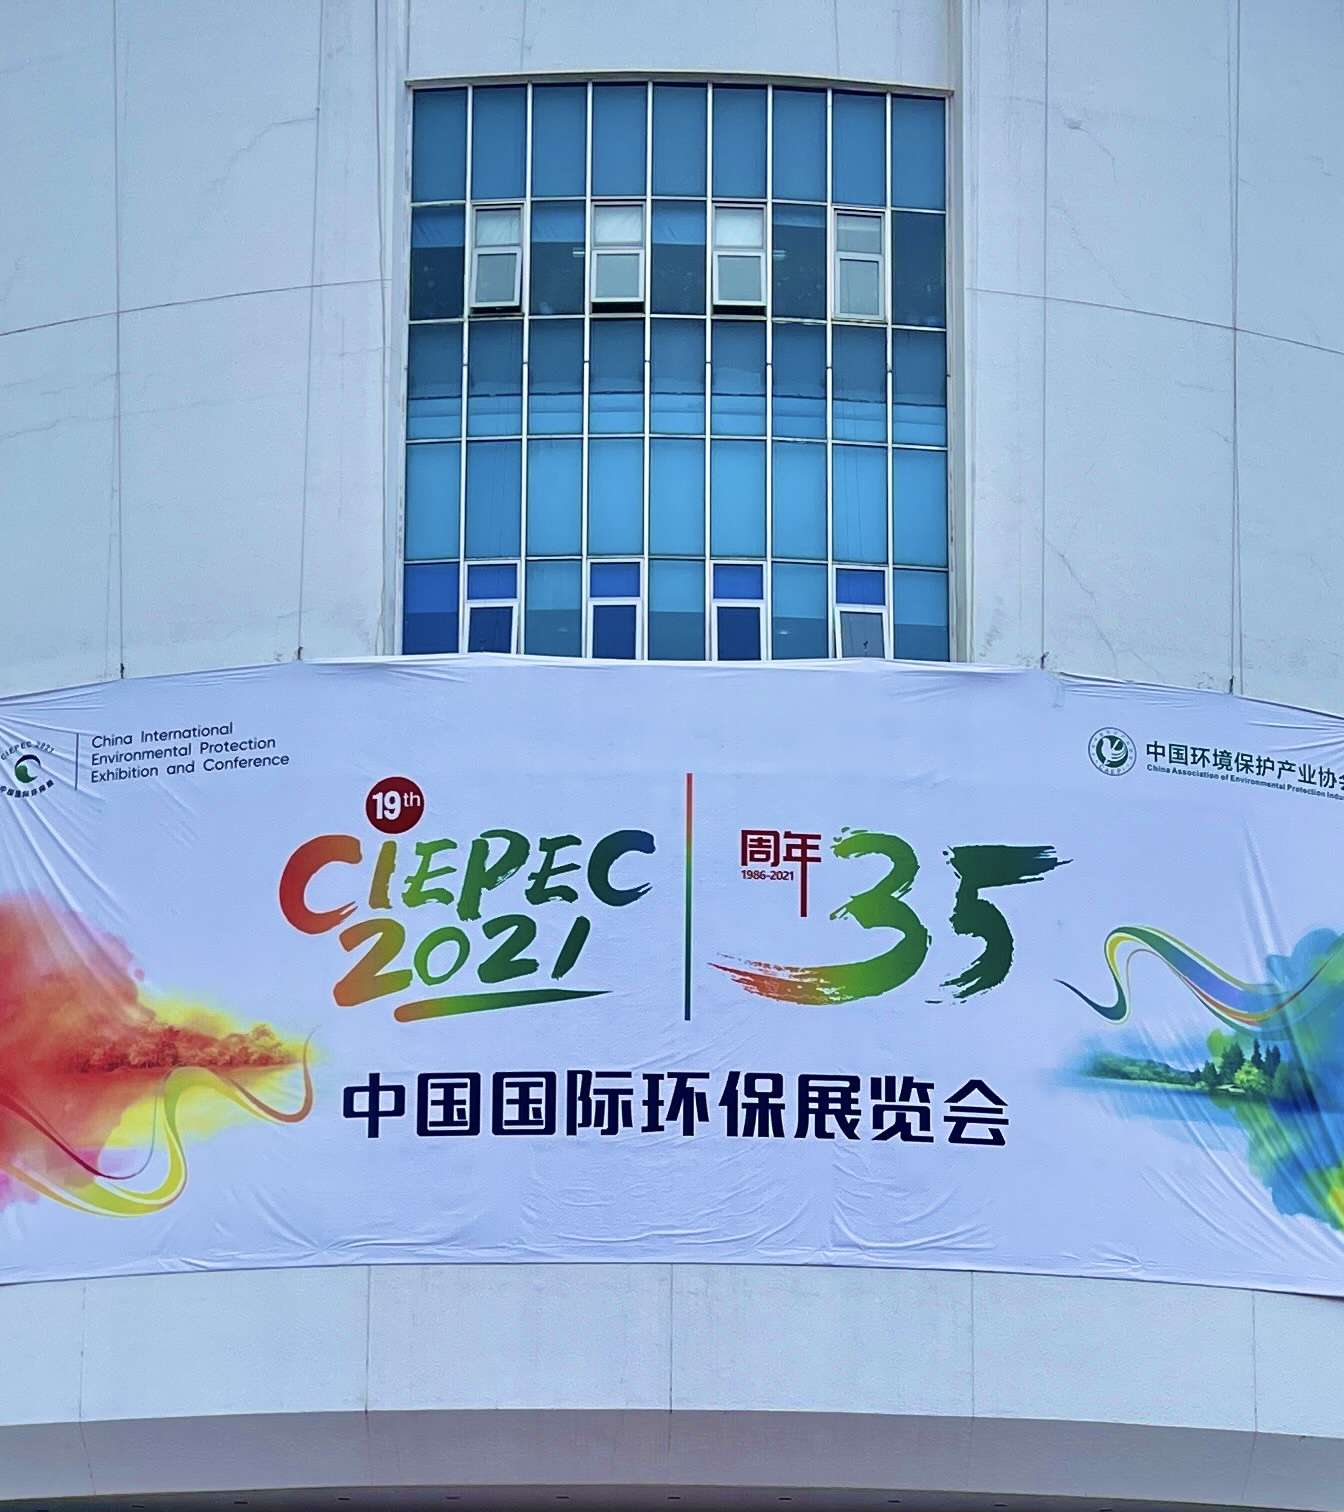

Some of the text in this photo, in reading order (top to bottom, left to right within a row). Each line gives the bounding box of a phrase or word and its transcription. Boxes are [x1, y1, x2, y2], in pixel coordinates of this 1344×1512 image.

[92, 722, 233, 749] China International
[92, 737, 276, 766] Environmental Protection
[91, 753, 290, 783] Exhibition and Conference
[1147, 763, 1171, 775] China
[1172, 767, 1219, 780] Association
[1220, 773, 1229, 782] of
[1230, 774, 1285, 791] Environmental
[1287, 783, 1325, 797] Protection
[371, 787, 421, 821] 19th
[279, 829, 656, 934] CIEPEC
[741, 830, 821, 917] 周年
[741, 869, 794, 881] 1986-2021
[707, 826, 1073, 1005] 35
[333, 915, 591, 1007] 2021
[343, 1070, 1009, 1146] 中国国际环保展览会
